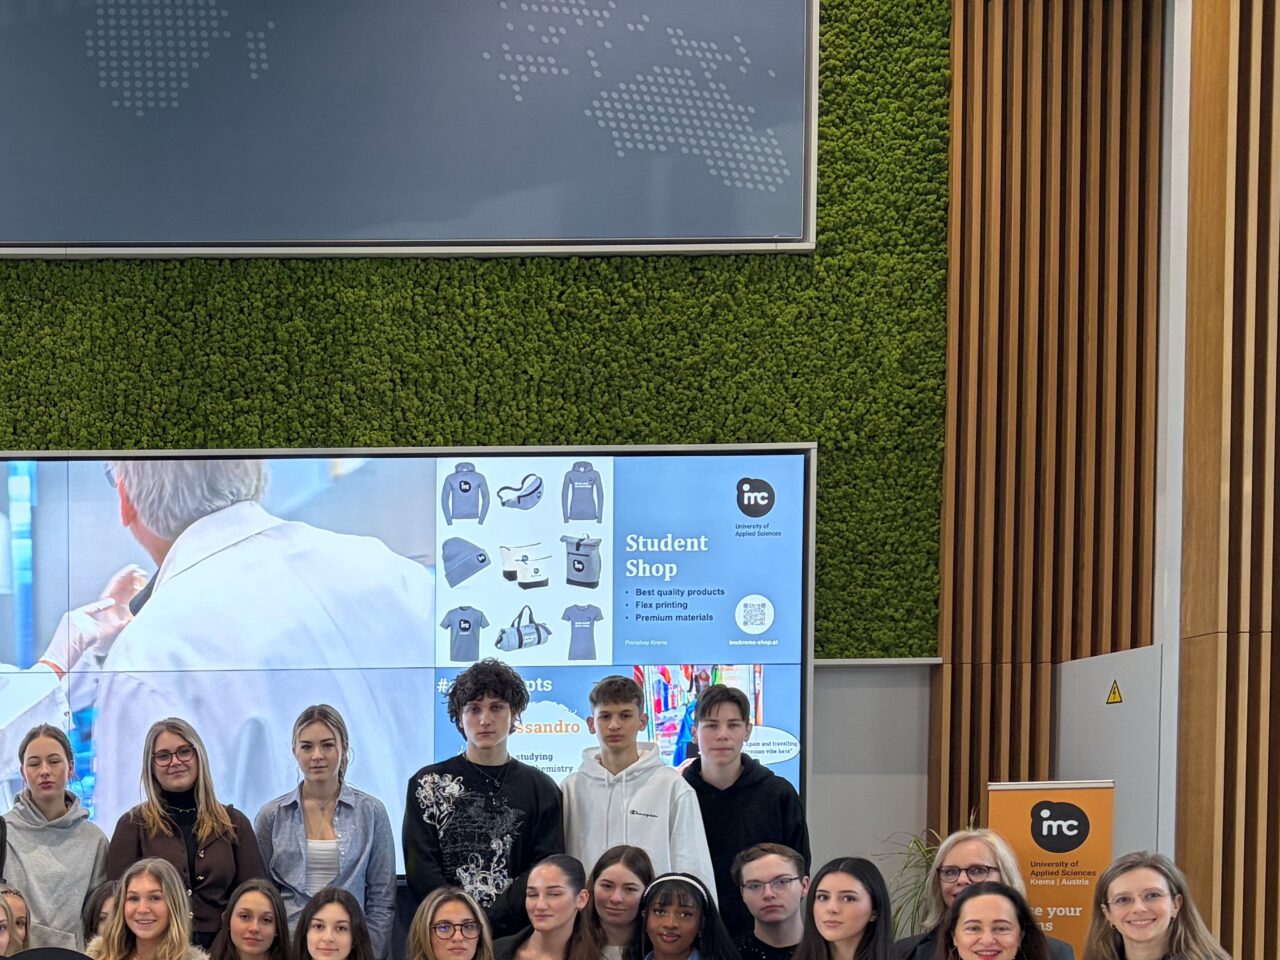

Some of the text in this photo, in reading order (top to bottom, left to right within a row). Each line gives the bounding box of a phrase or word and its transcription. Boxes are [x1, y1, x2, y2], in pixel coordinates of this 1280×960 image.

[742, 483, 769, 505] imc
[625, 533, 709, 552] Student
[625, 558, 678, 582] Shop
[635, 588, 726, 597] Best quality products
[635, 601, 688, 610] Flex printing
[635, 613, 714, 621] Premium materials
[516, 719, 581, 734] ssandro
[516, 752, 554, 763] studying
[1039, 808, 1080, 836] imc
[1030, 860, 1079, 869] University of
[1030, 869, 1097, 878] Applied Sciences
[1030, 878, 1056, 886] Krems
[1061, 878, 1090, 886] Austria
[1047, 905, 1083, 919] your
